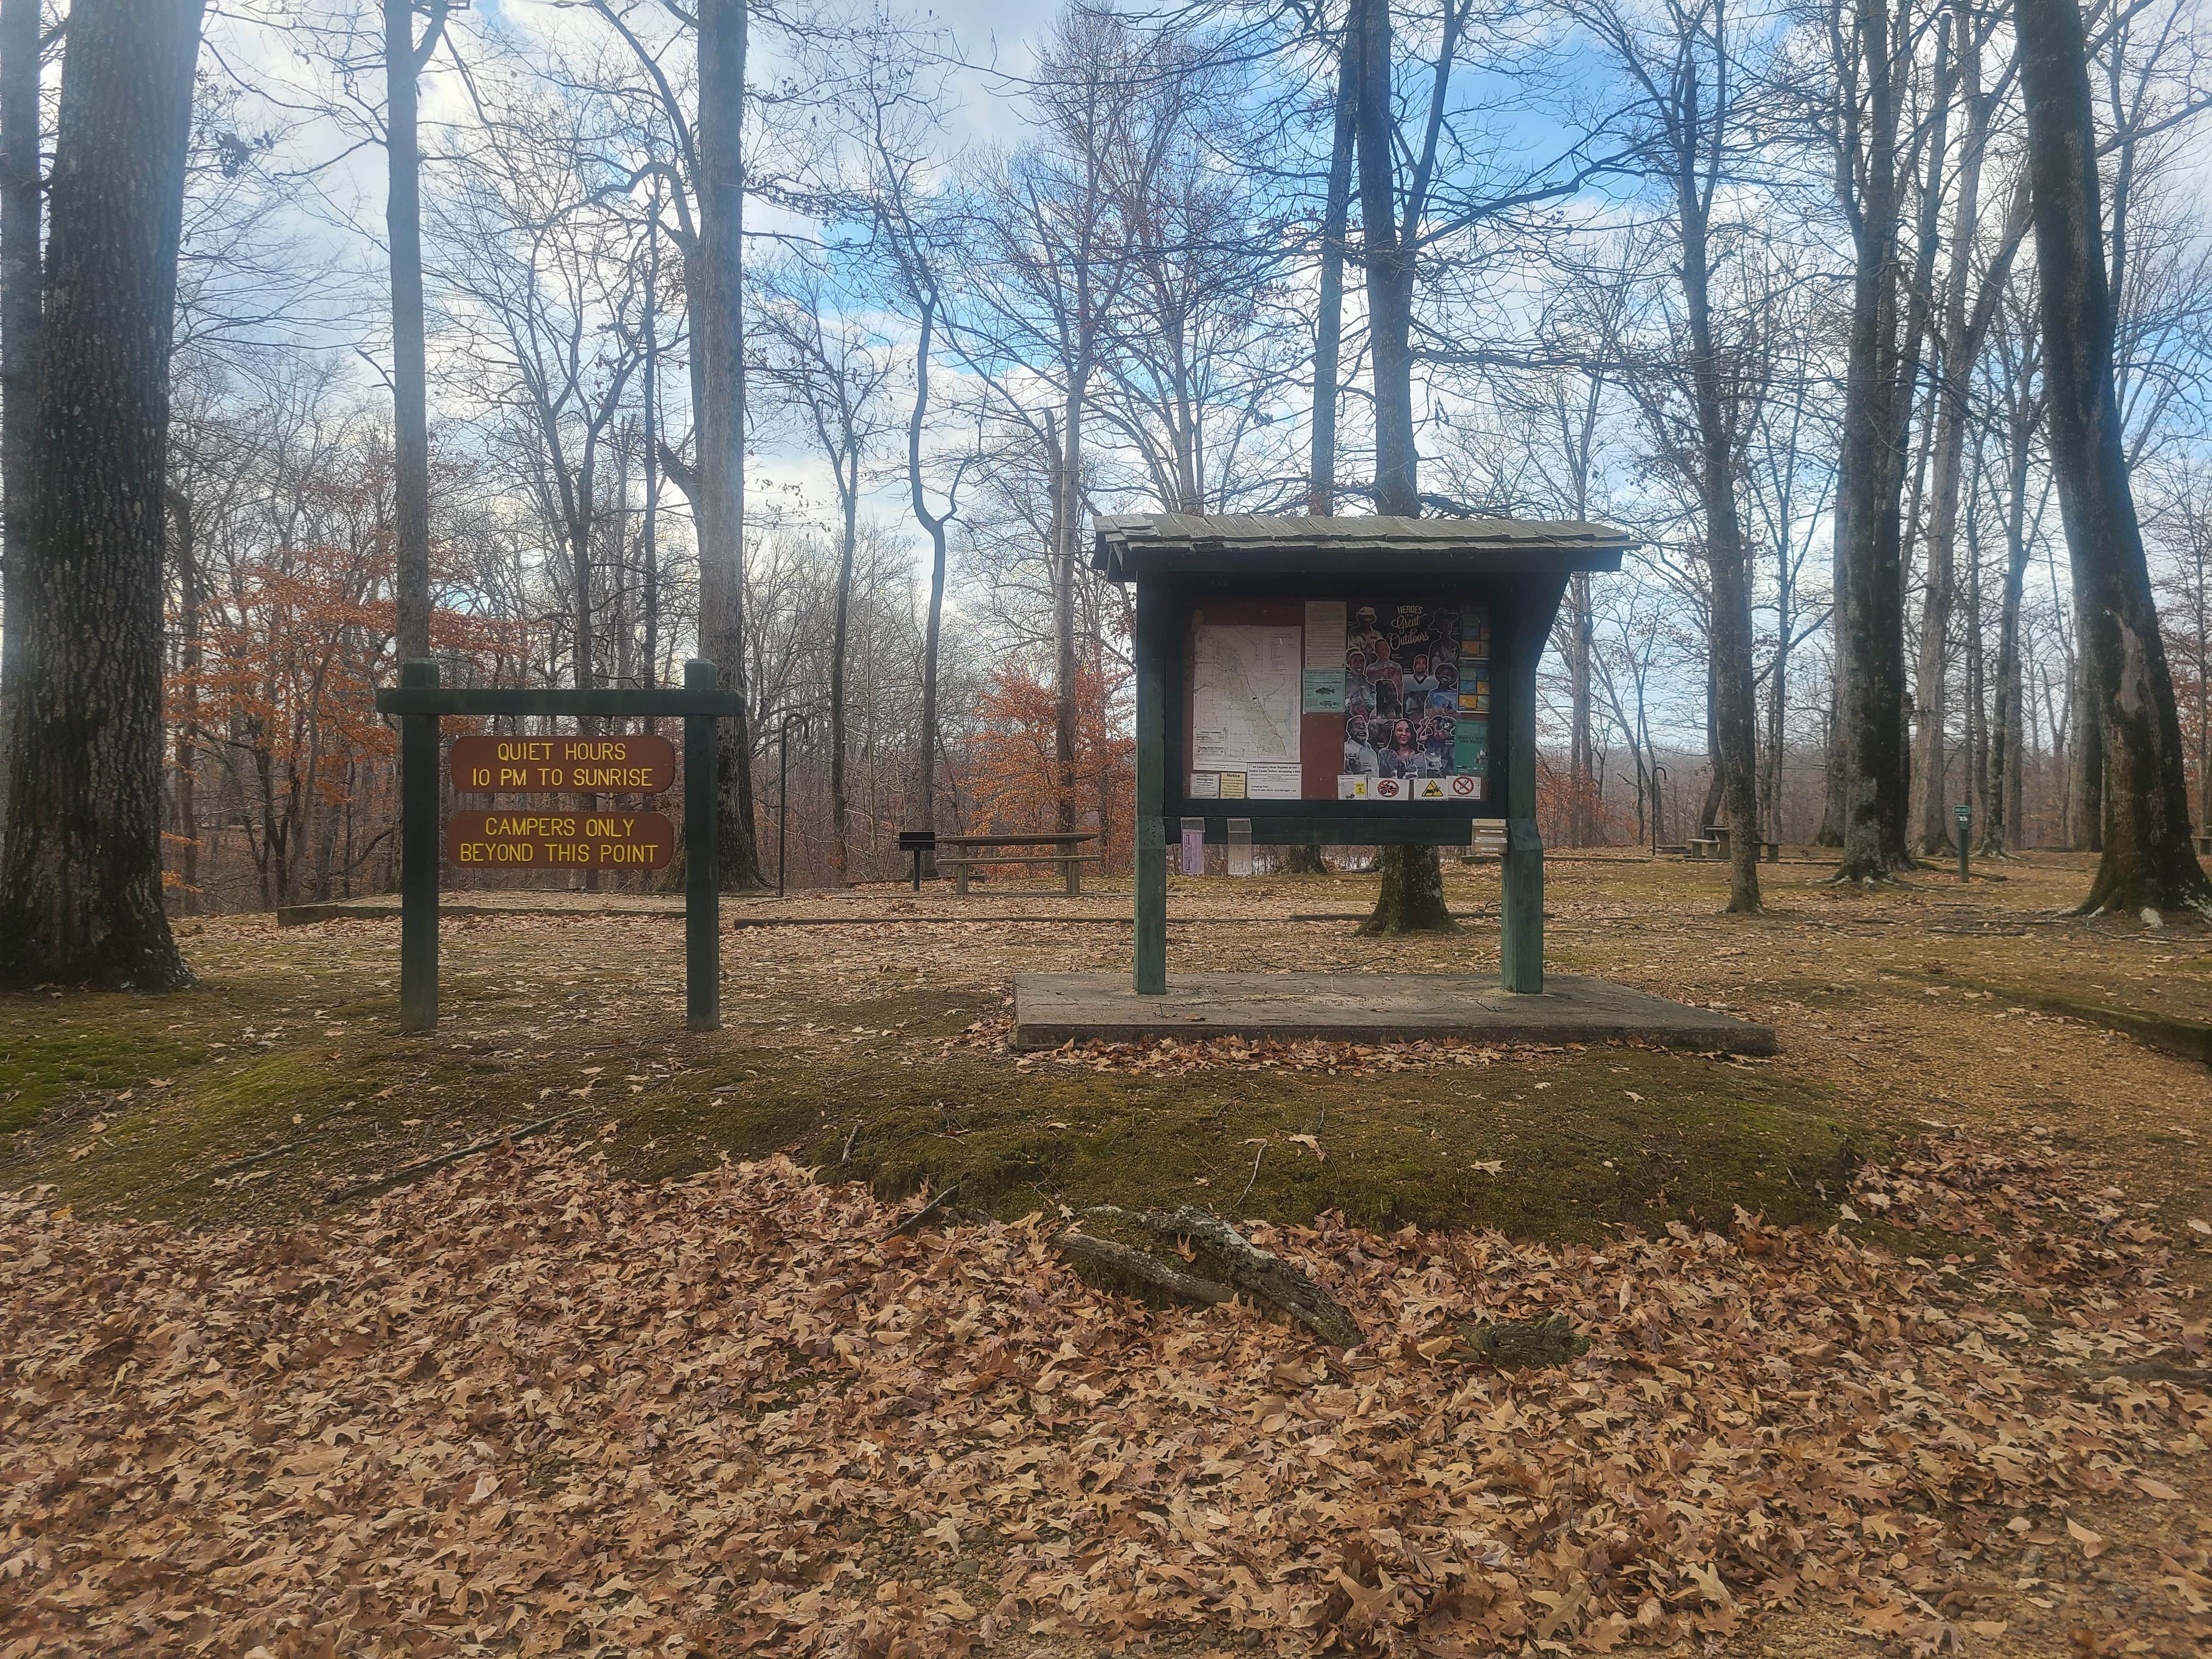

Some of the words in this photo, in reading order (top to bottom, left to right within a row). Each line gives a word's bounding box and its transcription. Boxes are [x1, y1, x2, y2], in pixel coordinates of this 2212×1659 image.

[1397, 606, 1423, 614] HEROES
[1391, 614, 1427, 634] Great
[1387, 629, 1429, 650] Outdoors
[498, 743, 554, 761] QUIET
[565, 743, 626, 760] HOURS
[472, 769, 490, 786] 10
[500, 768, 527, 786] PM
[538, 768, 563, 786] TO
[573, 768, 653, 786] SUNRISE
[485, 817, 575, 837] CAMPERS
[585, 819, 635, 838] ONLY
[460, 843, 534, 862] BEYOND
[545, 844, 590, 862] THIS
[600, 844, 659, 864] POINT
